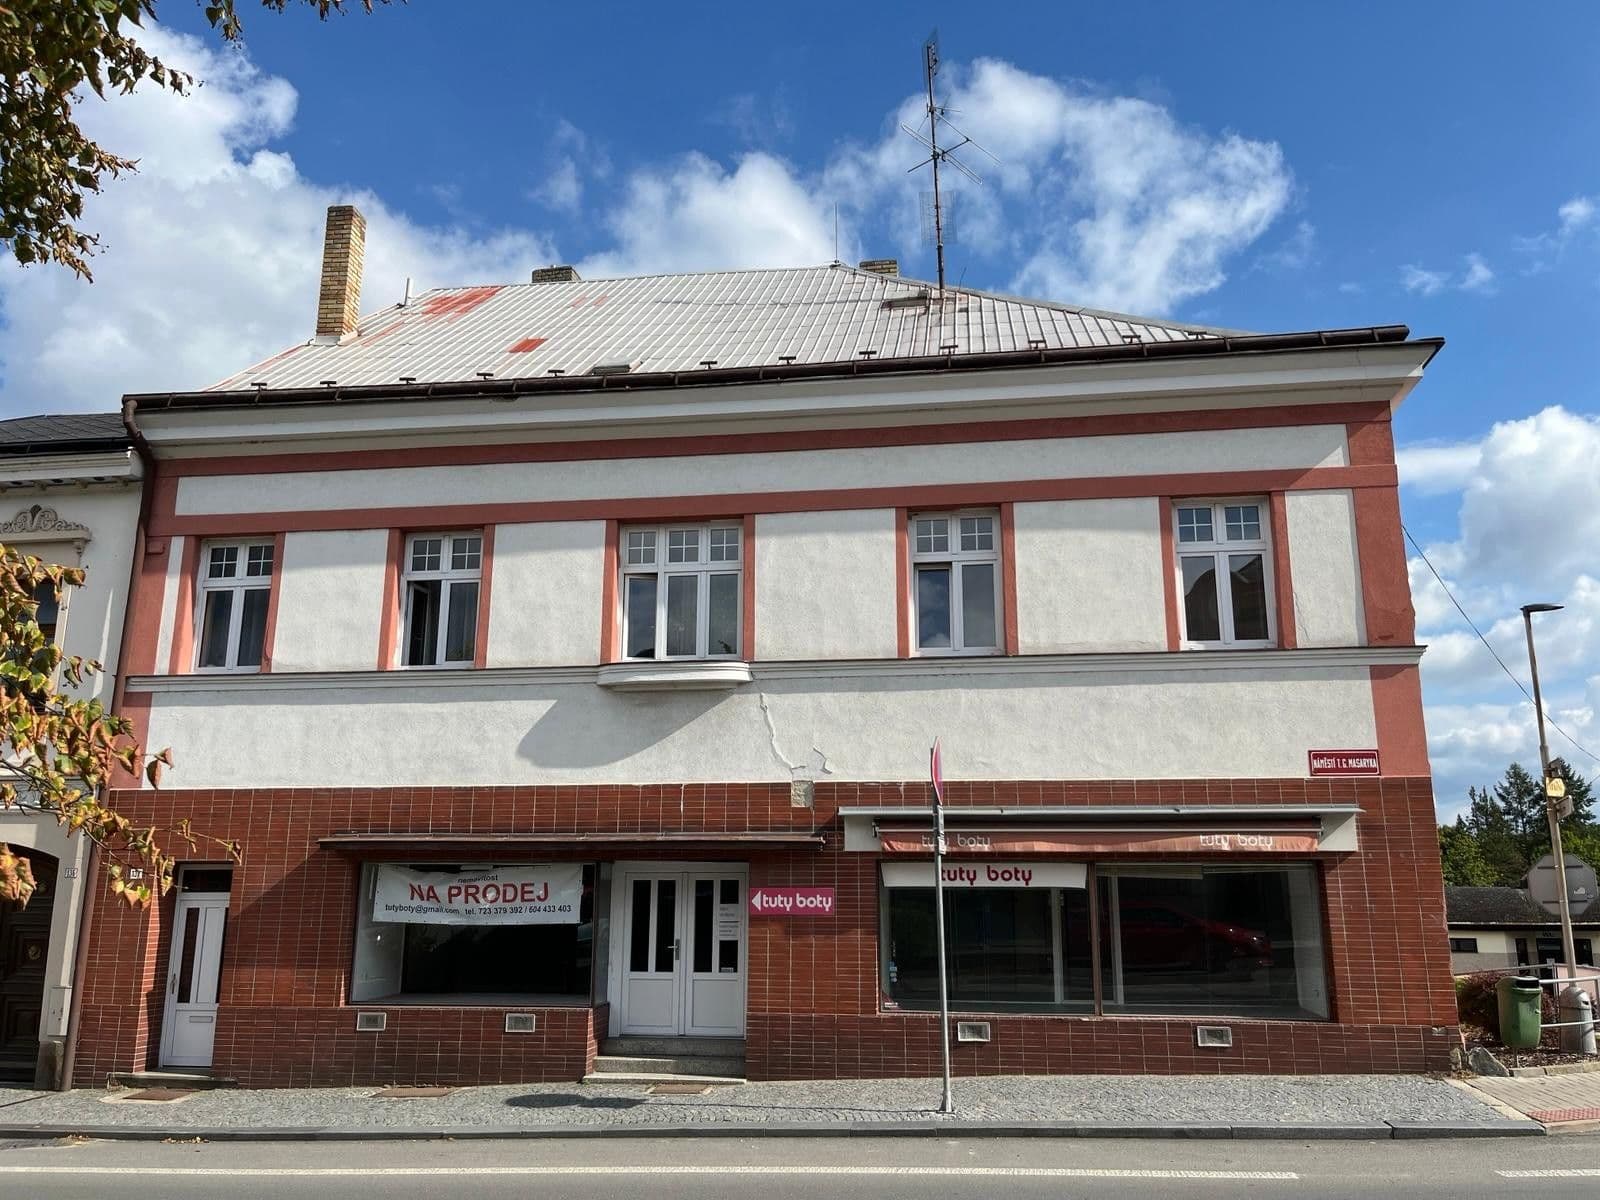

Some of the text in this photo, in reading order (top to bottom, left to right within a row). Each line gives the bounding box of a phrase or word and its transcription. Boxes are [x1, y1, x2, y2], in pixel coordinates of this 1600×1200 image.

[921, 834, 991, 848] tu boty
[940, 865, 1032, 886] tuty boty
[408, 882, 549, 904] NA PRODEJ
[762, 893, 832, 911] tuty boty
[464, 908, 476, 916] tel.
[478, 906, 493, 915] 723
[493, 906, 508, 915] 379
[509, 906, 524, 914] 392
[542, 905, 556, 913] 433
[557, 904, 572, 913] 403
